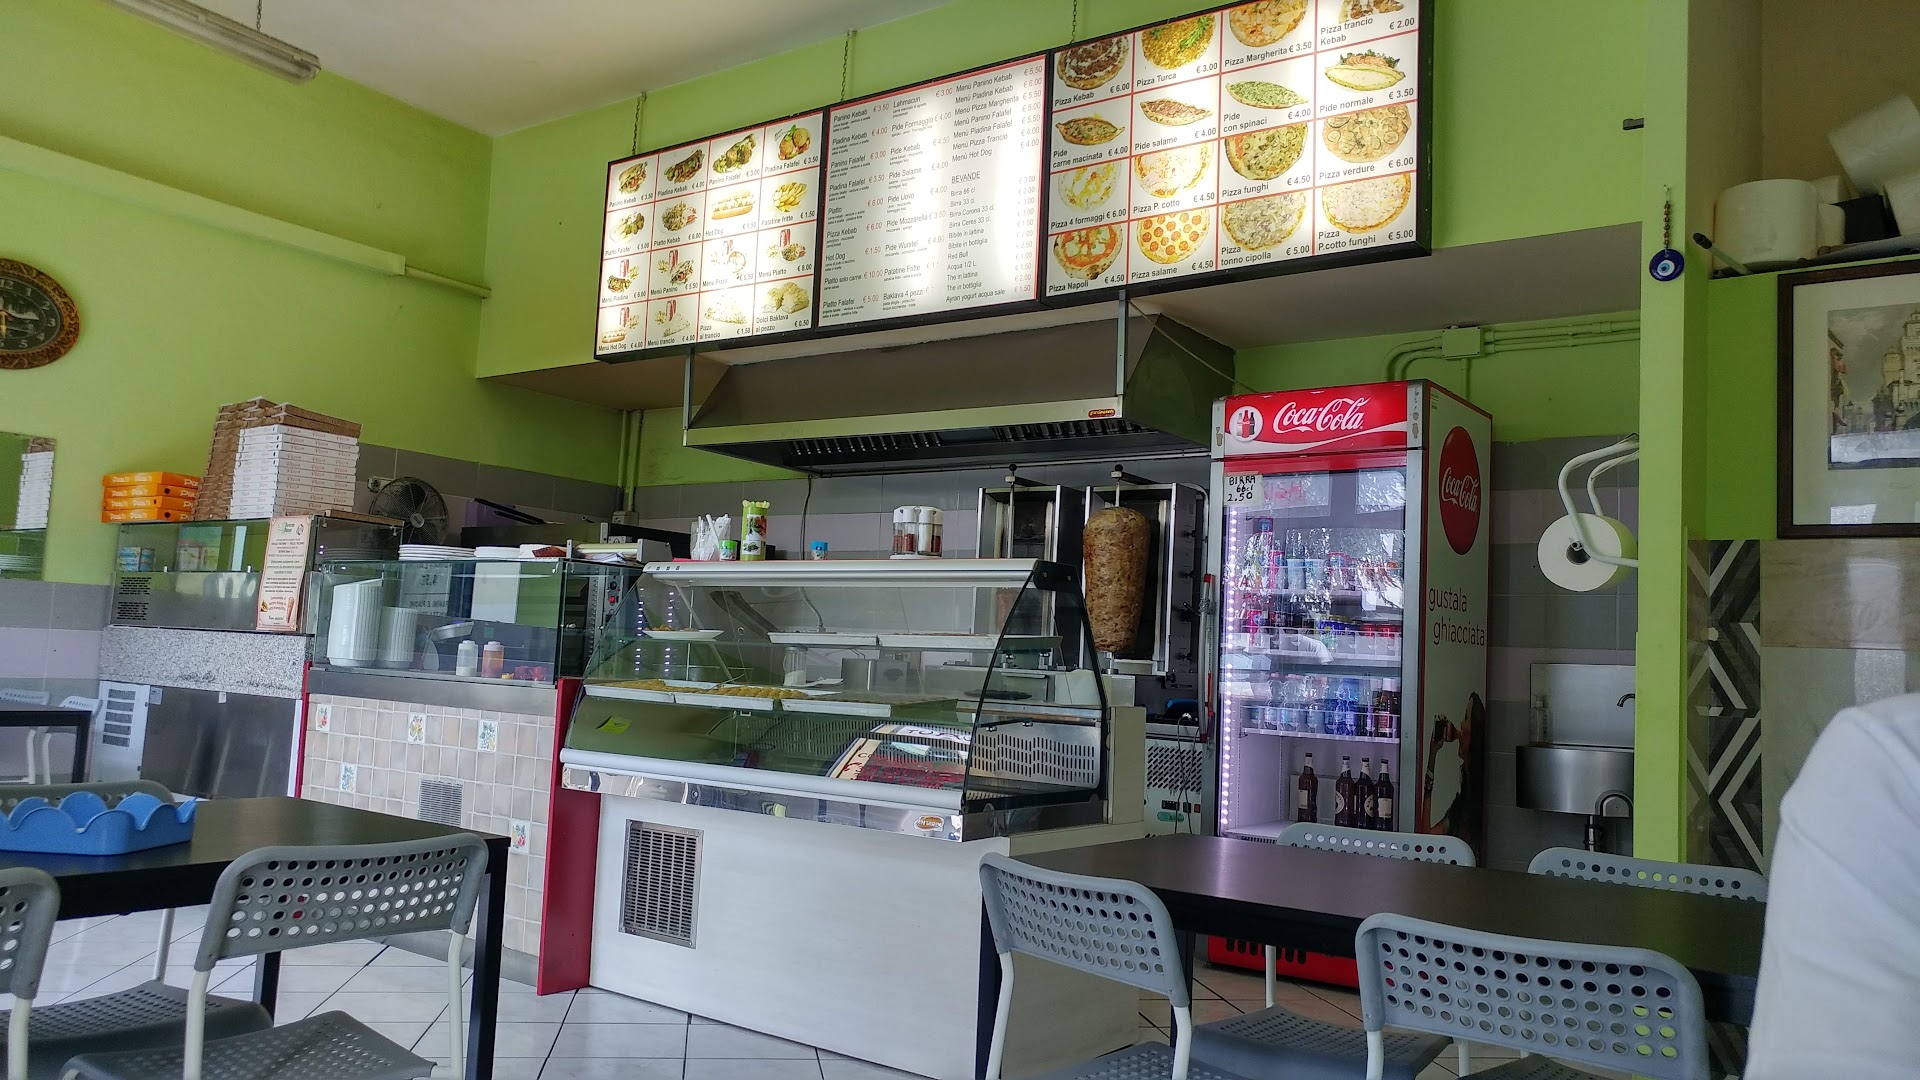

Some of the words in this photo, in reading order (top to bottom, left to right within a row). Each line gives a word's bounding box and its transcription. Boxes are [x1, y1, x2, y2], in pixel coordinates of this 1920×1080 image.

[1321, 25, 1341, 35] Pizza
[1344, 17, 1373, 30] trancio
[1397, 18, 1415, 29] 2.00
[1321, 34, 1346, 46] Kebab
[1225, 58, 1244, 67] Pizza
[1247, 48, 1287, 63] Margherita
[1296, 41, 1312, 51] 3.50
[973, 79, 992, 88] Panino
[994, 73, 1012, 82] Kebab
[1136, 78, 1155, 87] Pizza
[1157, 72, 1176, 83] Turca
[1196, 66, 1201, 74] €
[1202, 63, 1218, 72] 3.00
[972, 90, 993, 100] Piadina
[995, 84, 1014, 94] Kebab
[1054, 97, 1072, 106] Pizza
[1074, 92, 1094, 101] Kebab
[1116, 82, 1130, 93] 6.00
[894, 96, 921, 108] Lahmacun
[972, 102, 987, 111] Pizza
[988, 95, 1019, 107] Margherita
[1320, 104, 1337, 113] Pide
[1340, 96, 1373, 109] normale
[1396, 88, 1414, 98] 3.50
[834, 114, 850, 122] Panino
[852, 109, 868, 118] Kebab
[878, 103, 889, 111] 3.50
[971, 113, 990, 123] Panino
[992, 108, 1012, 118] Falafel
[1223, 112, 1240, 122] Pide
[1288, 112, 1292, 120] €
[1295, 108, 1311, 118] 4.00
[970, 124, 991, 134] Piadina
[993, 120, 1012, 130] Falafel
[1223, 124, 1237, 132] con
[1240, 117, 1267, 131] spinaci
[832, 136, 850, 145] Piadina
[851, 132, 867, 141] Kebab
[876, 127, 888, 135] 4.00
[970, 137, 985, 146] Pizza
[987, 134, 1008, 142] Trancio
[1135, 141, 1150, 151] Pide
[1152, 136, 1177, 148] salame
[1201, 128, 1216, 137] 4.00
[969, 150, 979, 158] Hot
[980, 148, 992, 157] Dog
[1053, 150, 1067, 158] Pide
[1114, 146, 1128, 156] 4.00
[831, 160, 847, 168] Panino
[849, 155, 866, 164] Falafel
[1053, 159, 1070, 168] carne
[1072, 152, 1102, 165] macinata
[1319, 170, 1340, 180] Pizza
[1343, 164, 1375, 176] verdure
[1388, 160, 1393, 168] €
[1396, 156, 1414, 167] 6.00
[830, 183, 847, 191] Piadina
[849, 178, 865, 188] Falafel
[952, 171, 981, 183] BEVANDE
[1222, 188, 1242, 198] Pizza
[1244, 182, 1269, 196] funghi
[1294, 175, 1310, 184] 4.50
[1133, 205, 1151, 214] Pizza
[1153, 202, 1160, 210] P.
[1162, 200, 1180, 209] cotto
[1199, 192, 1215, 201] 4.50
[1051, 220, 1068, 229] Pizza
[1075, 213, 1105, 226] formaggi
[1112, 209, 1126, 218] 6.00
[841, 227, 857, 235] Kebab
[871, 222, 882, 230] 6.00
[1318, 230, 1340, 240] Pizza
[1318, 240, 1346, 251] P.cotto
[1349, 235, 1376, 248] funghi
[1396, 229, 1414, 239] 5.00
[836, 252, 846, 261] Dog
[1221, 246, 1241, 255] Pizza
[1286, 247, 1291, 256] €
[1293, 245, 1310, 255] 5.00
[1221, 256, 1243, 266] tonno
[1245, 251, 1271, 264] cipolla
[1132, 272, 1150, 280] Pizza
[1152, 266, 1177, 276] salame
[1198, 259, 1214, 269] 4.50
[1049, 284, 1066, 293] Pizza
[1067, 280, 1088, 291] Napoli
[1110, 274, 1125, 283] 4.50
[838, 298, 855, 306] Falafel
[883, 292, 904, 300] Baklava
[42, 301, 50, 310] 2
[47, 318, 56, 327] 3
[1273, 396, 1371, 434] Coca-Cola
[1229, 475, 1256, 485] BIRRA
[1228, 492, 1252, 501] 2.50
[1441, 467, 1479, 513] Coca-Cola
[1429, 587, 1467, 612] gustala
[1434, 616, 1484, 646] ghiacciata
